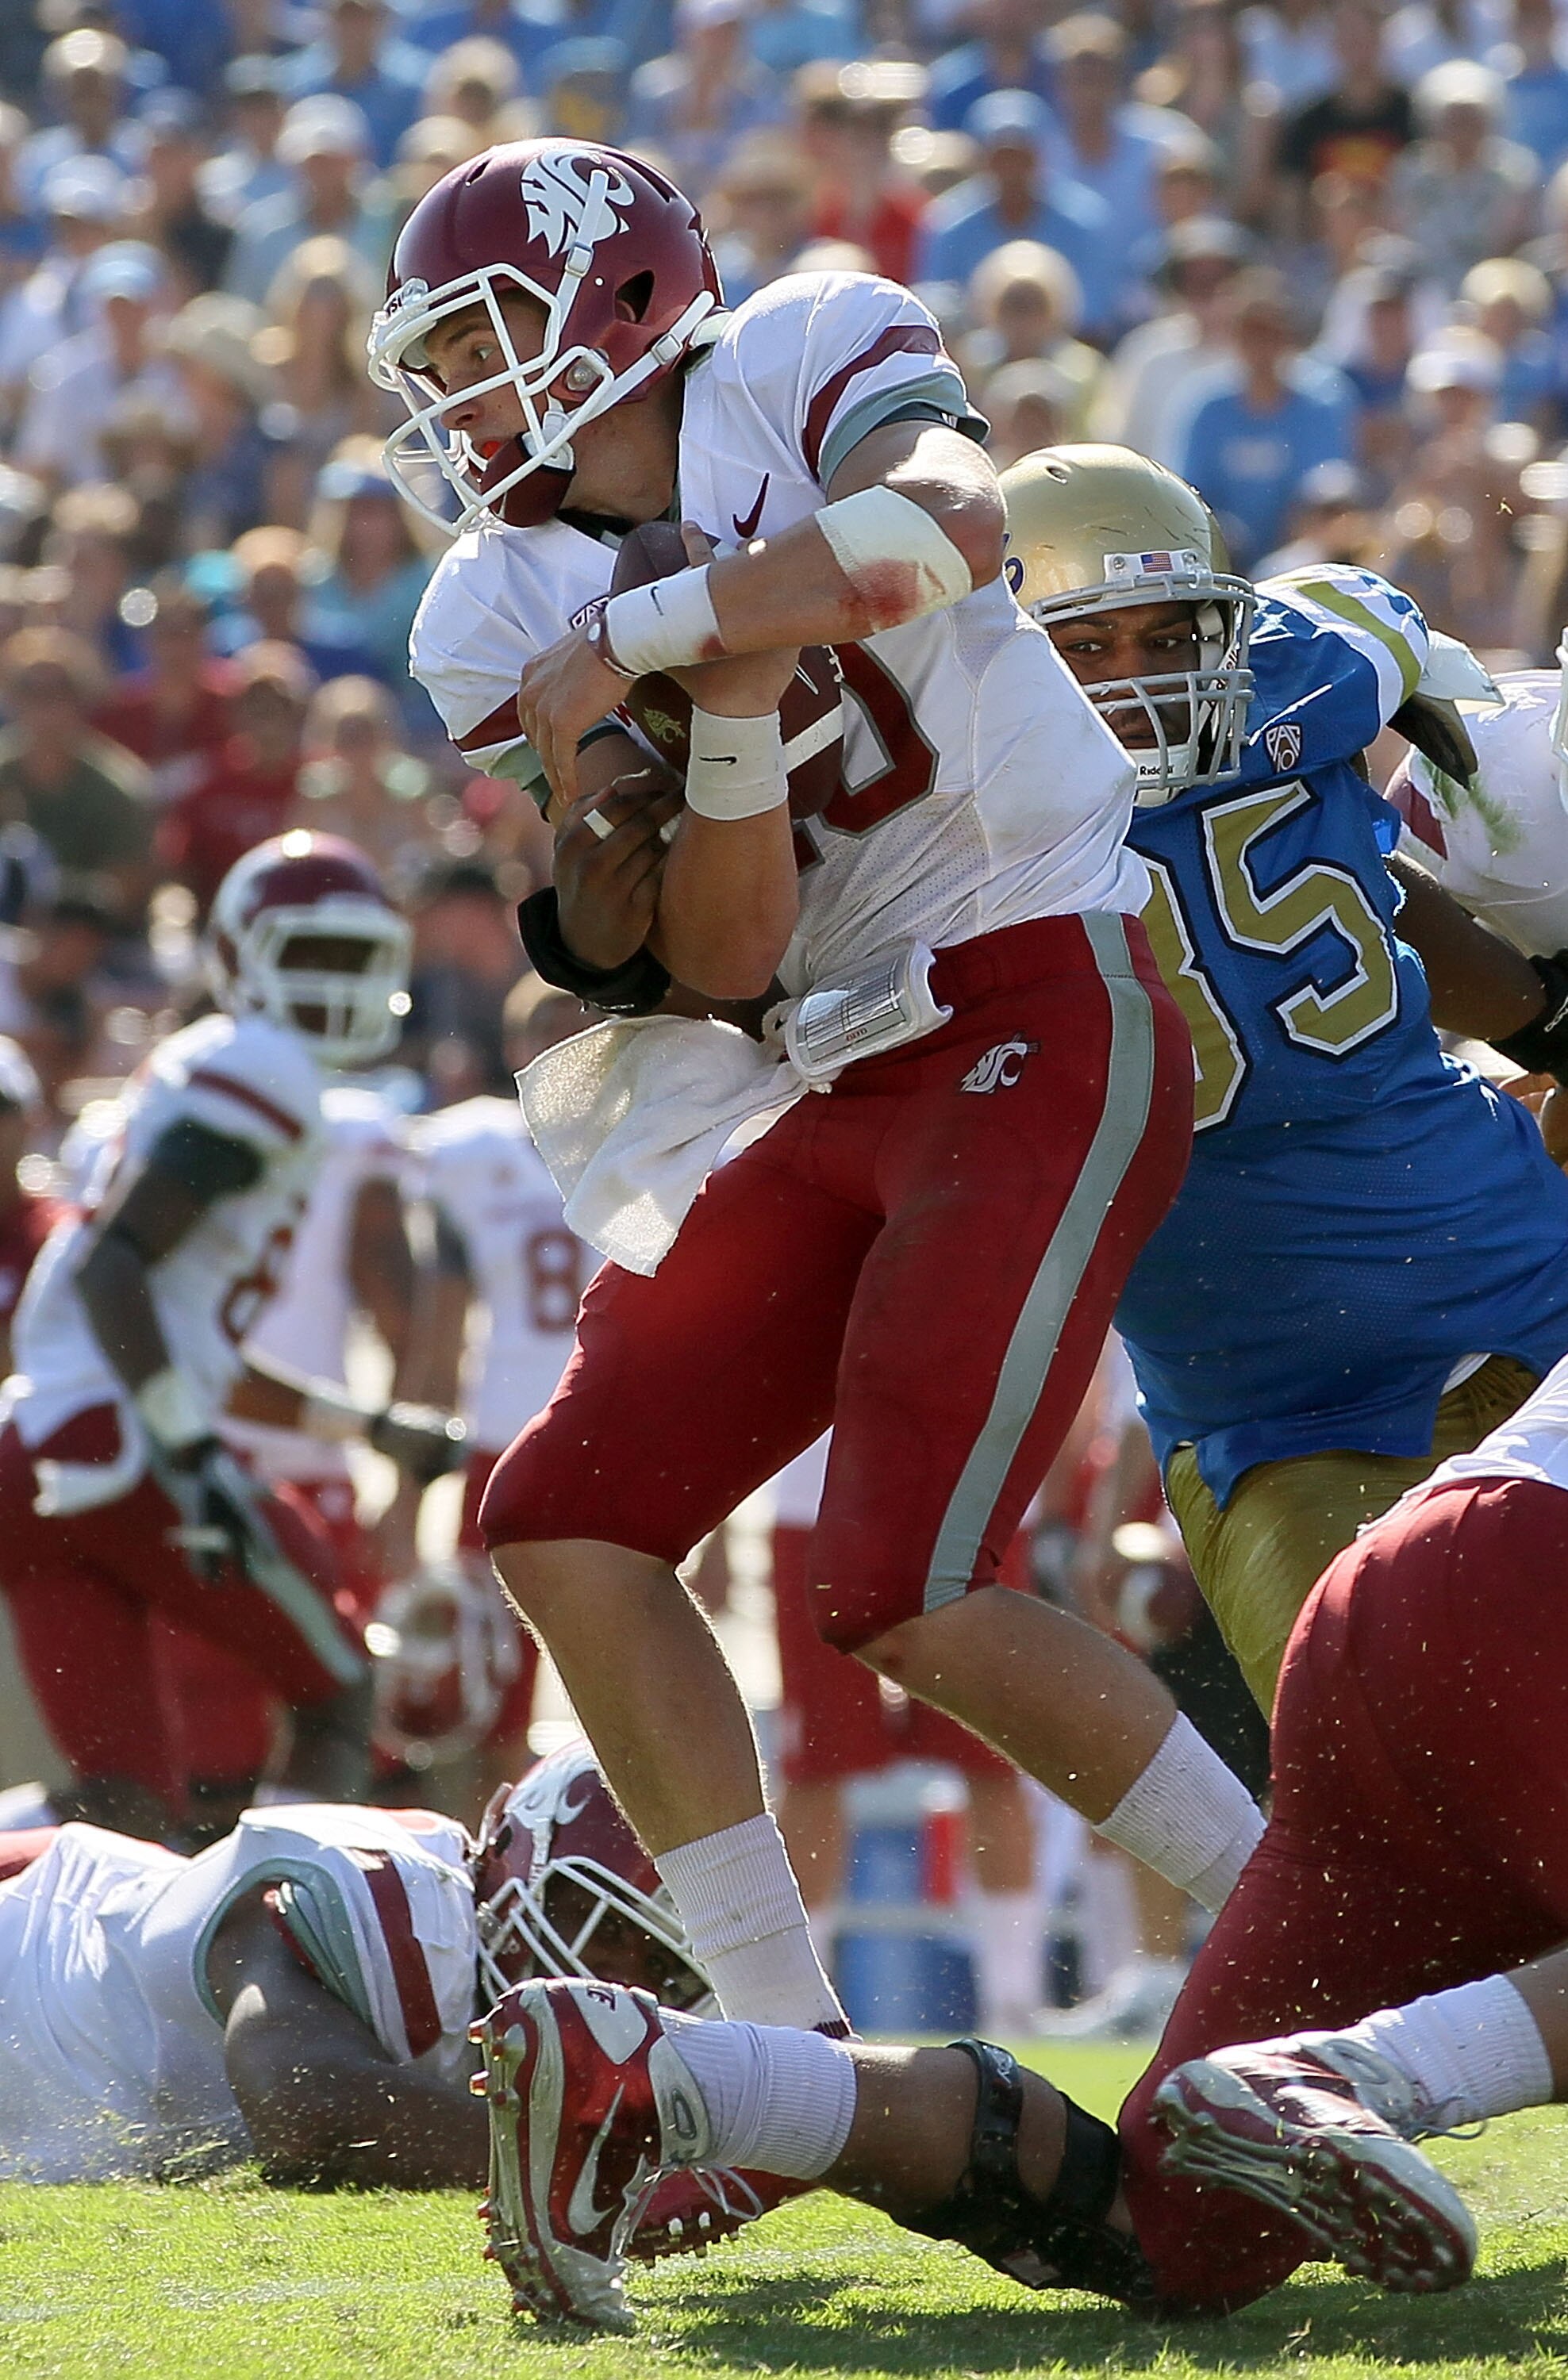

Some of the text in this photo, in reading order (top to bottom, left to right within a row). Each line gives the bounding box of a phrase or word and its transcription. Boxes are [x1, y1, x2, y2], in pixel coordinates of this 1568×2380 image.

[1266, 724, 1301, 762] PAC
[1139, 764, 1174, 776] Riddll
[1277, 749, 1296, 774] 10
